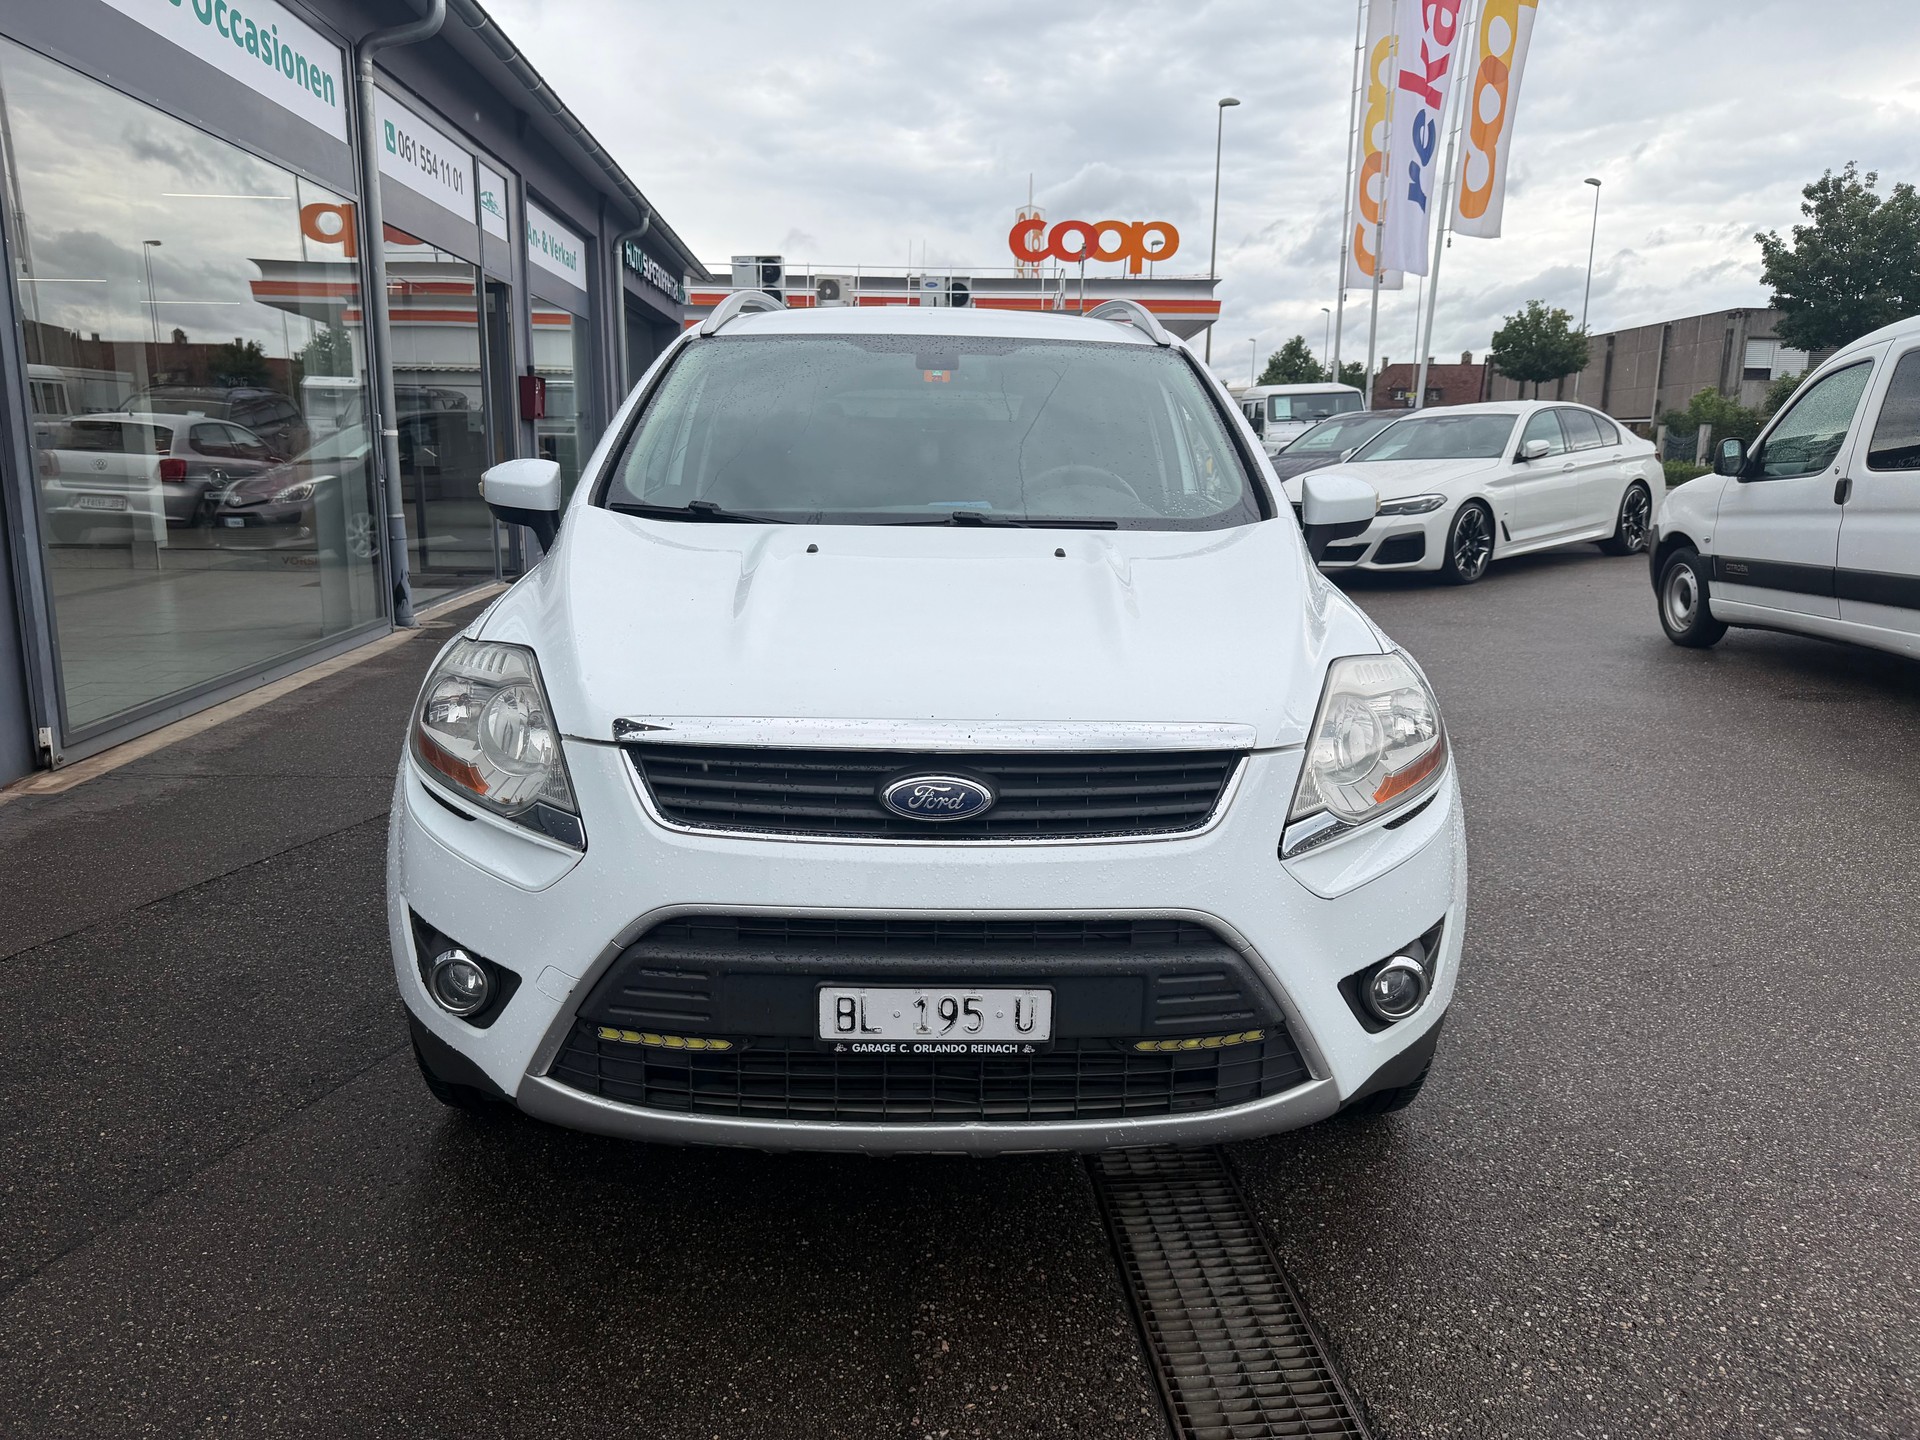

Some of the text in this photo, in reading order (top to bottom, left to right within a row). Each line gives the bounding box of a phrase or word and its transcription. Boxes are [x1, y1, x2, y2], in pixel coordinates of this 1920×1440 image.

[1460, 0, 1539, 219] coo
[397, 130, 463, 195] 061 554 11 01
[542, 230, 548, 255] &
[549, 234, 576, 272] Verkauf
[1009, 219, 1180, 274] coop
[908, 785, 965, 809] Ford
[834, 993, 1037, 1036] BL 195 U
[852, 1043, 1018, 1053] GARAGE C. ORLANDO REINACH
